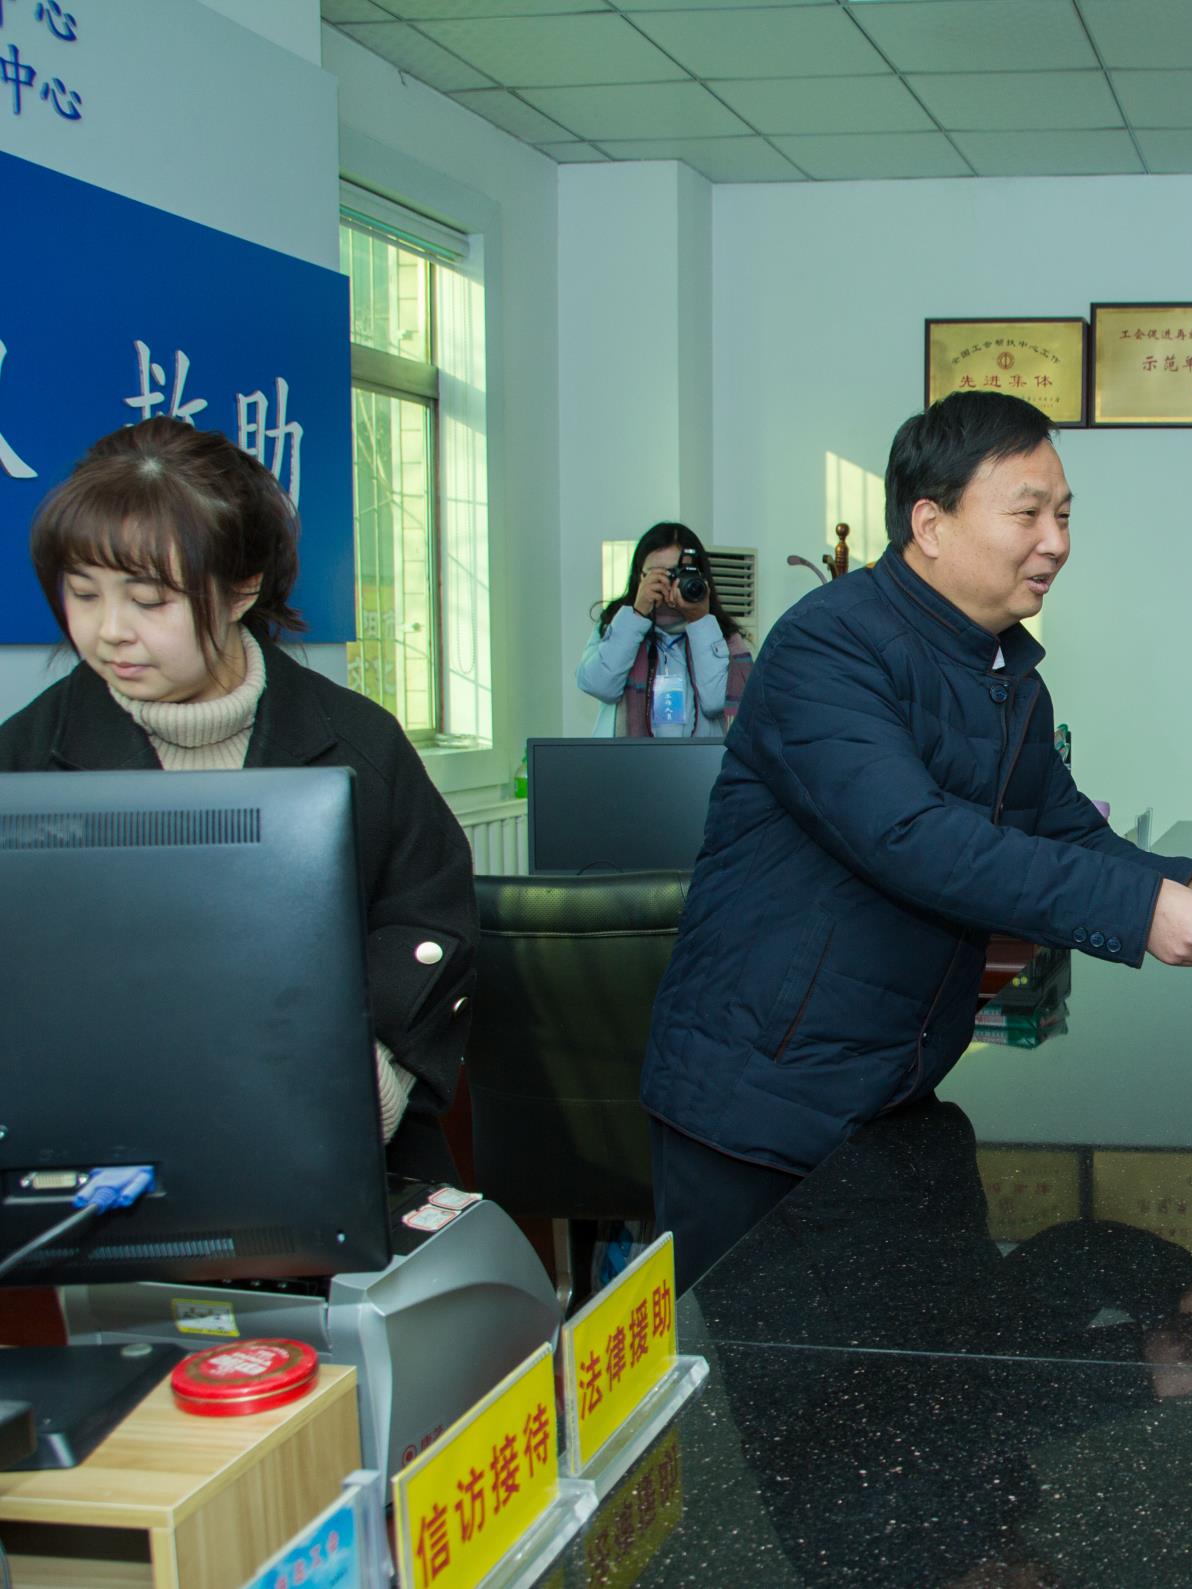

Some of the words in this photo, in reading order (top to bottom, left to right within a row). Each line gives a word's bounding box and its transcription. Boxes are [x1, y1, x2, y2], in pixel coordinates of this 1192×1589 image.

[0, 0, 77, 42] 心
[958, 374, 1054, 389] 先进集体
[578, 1279, 672, 1421] 法律援助
[416, 1402, 550, 1589] 信访接待
